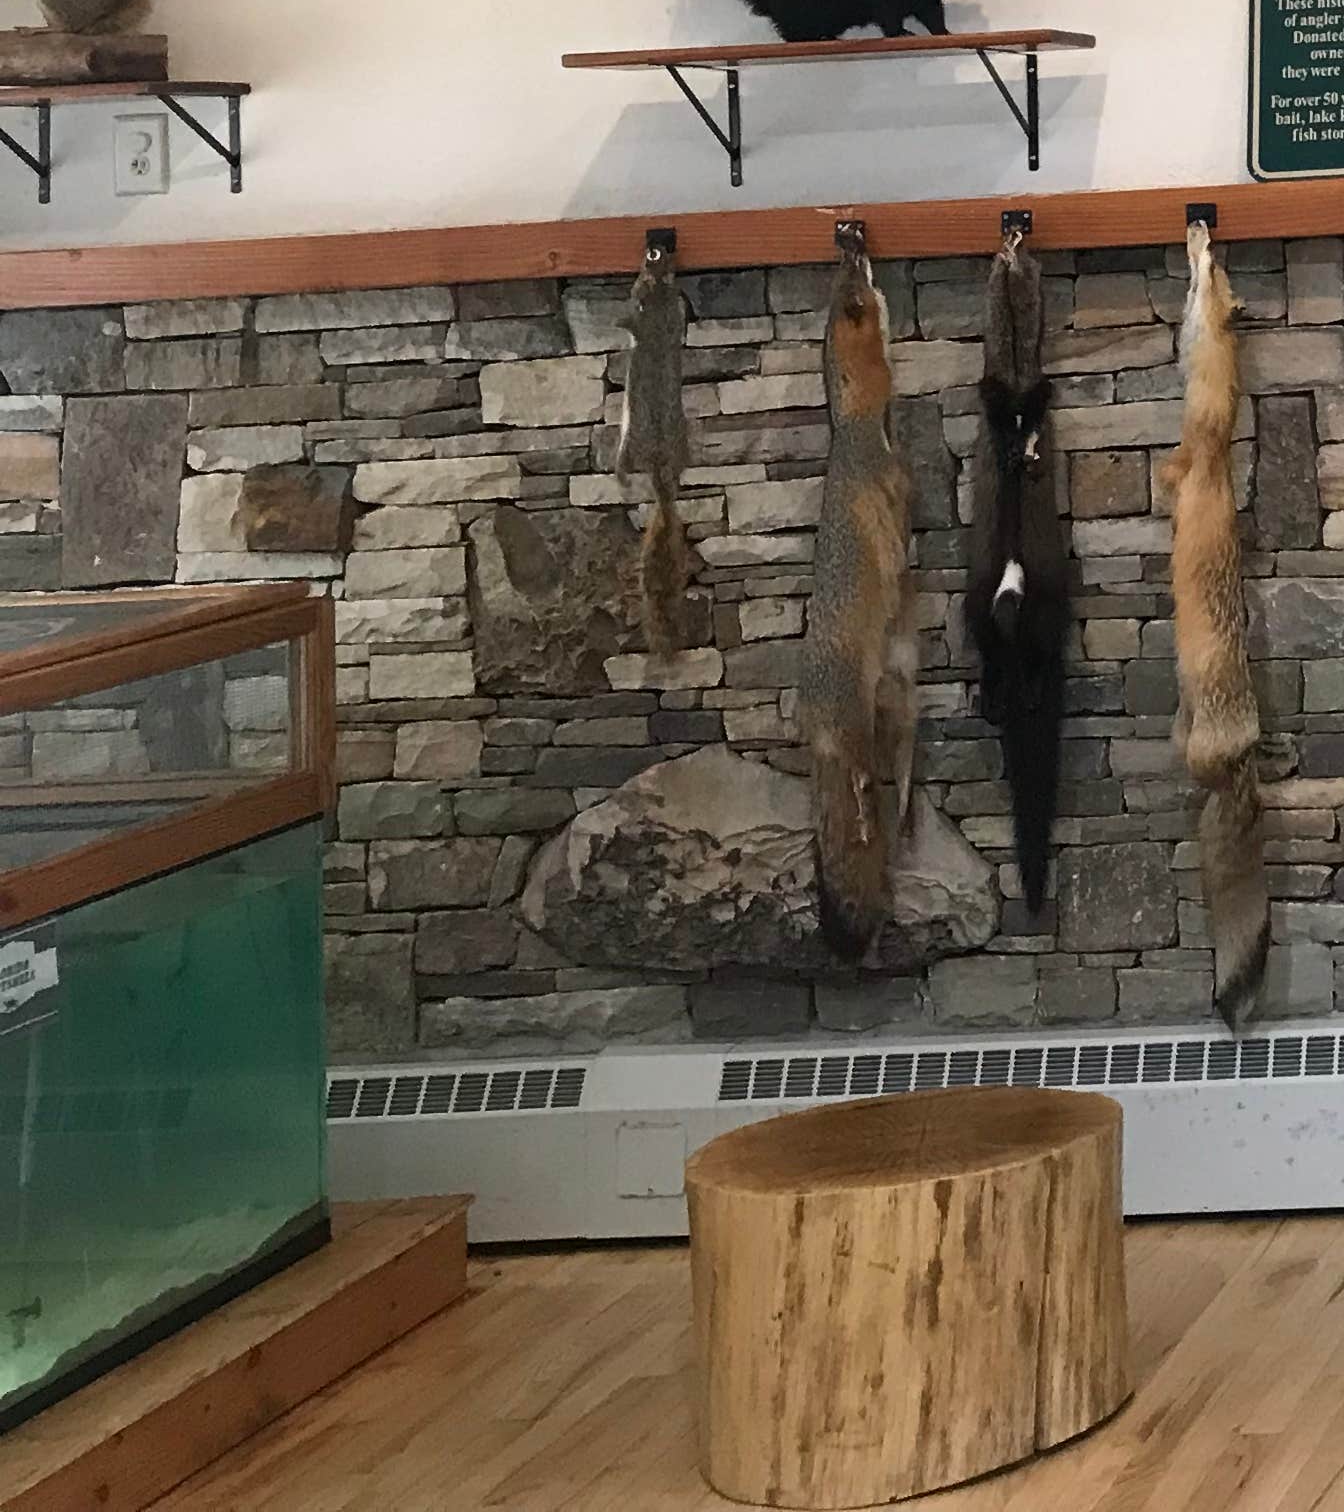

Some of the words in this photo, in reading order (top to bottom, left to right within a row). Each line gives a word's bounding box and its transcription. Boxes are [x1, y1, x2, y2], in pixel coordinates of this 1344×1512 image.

[1284, 14, 1296, 27] of
[1300, 12, 1339, 28] angler
[1282, 64, 1309, 80] they
[1311, 65, 1340, 77] were
[1271, 94, 1292, 108] For
[1294, 96, 1320, 107] over
[1322, 92, 1338, 106] 50
[1275, 110, 1306, 126] bait,
[1309, 109, 1336, 123] lake
[1292, 128, 1317, 142] fish
